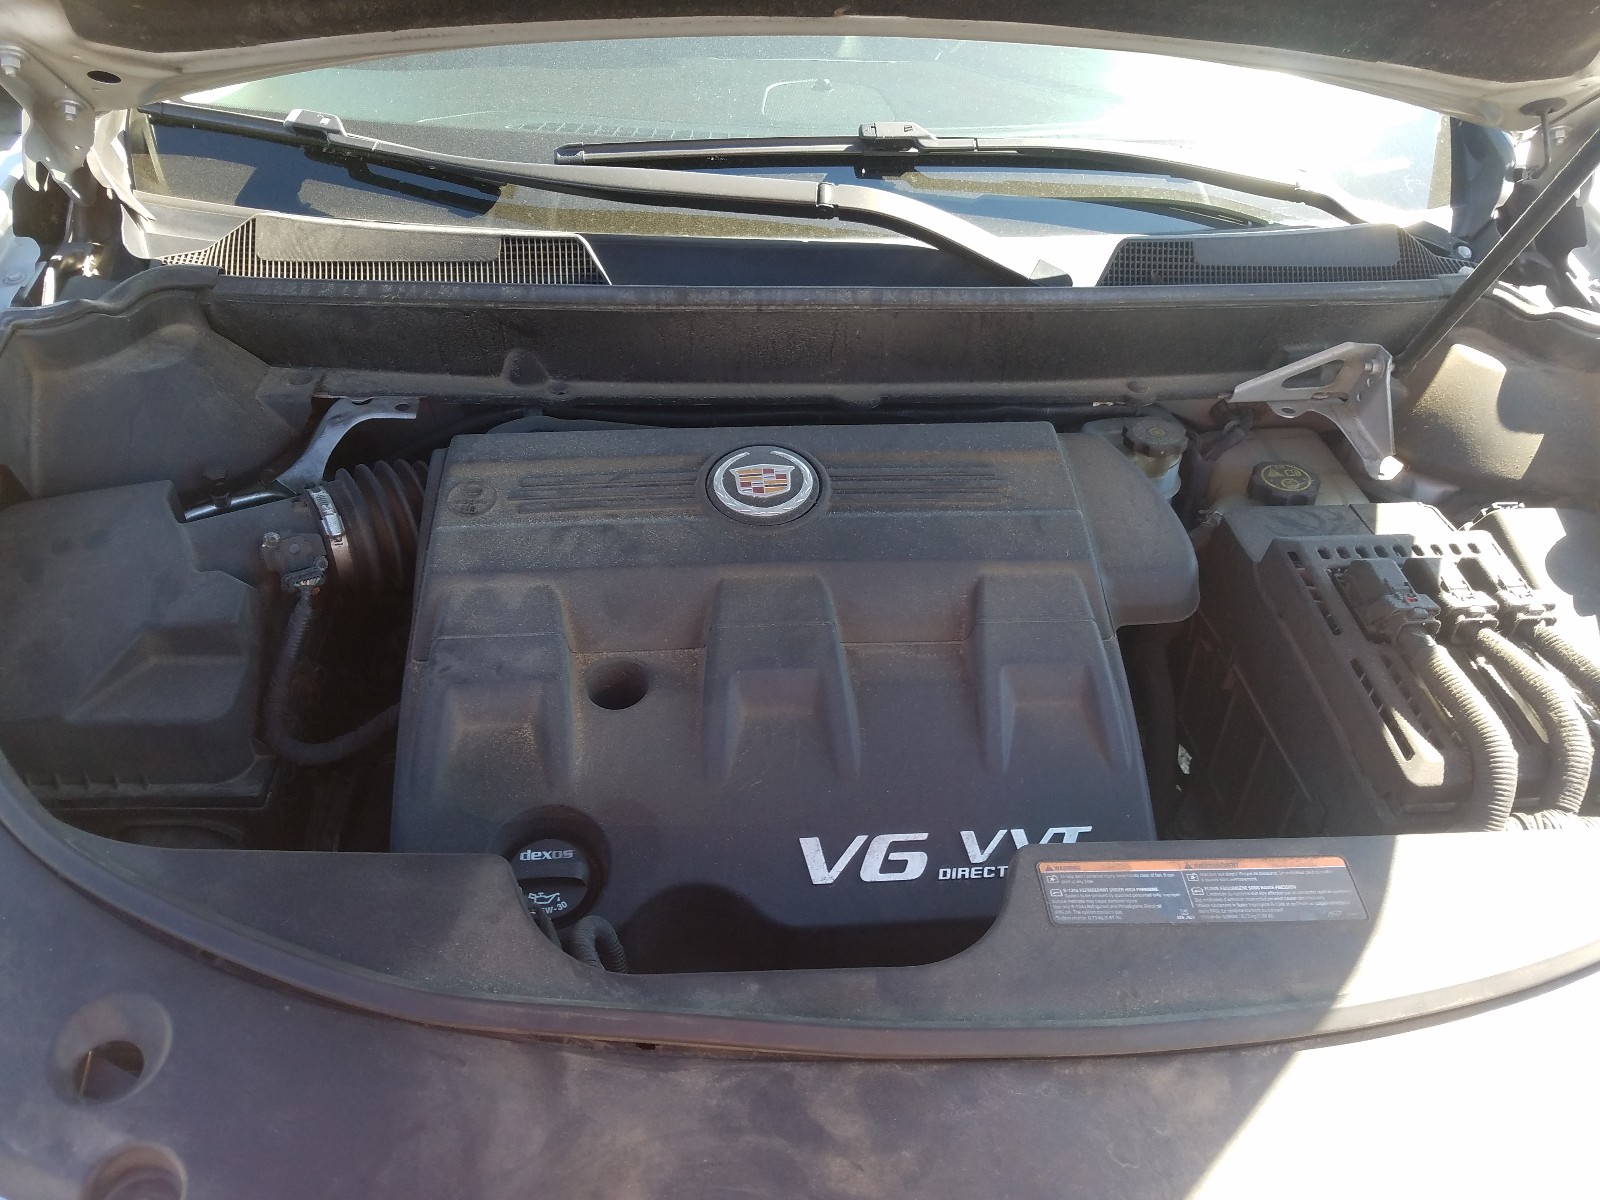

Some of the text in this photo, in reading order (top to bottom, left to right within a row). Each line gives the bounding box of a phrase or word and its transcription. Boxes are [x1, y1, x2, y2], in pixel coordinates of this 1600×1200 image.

[519, 849, 576, 861] dexos
[799, 832, 929, 885] V6
[937, 865, 1009, 880] DIRECT
